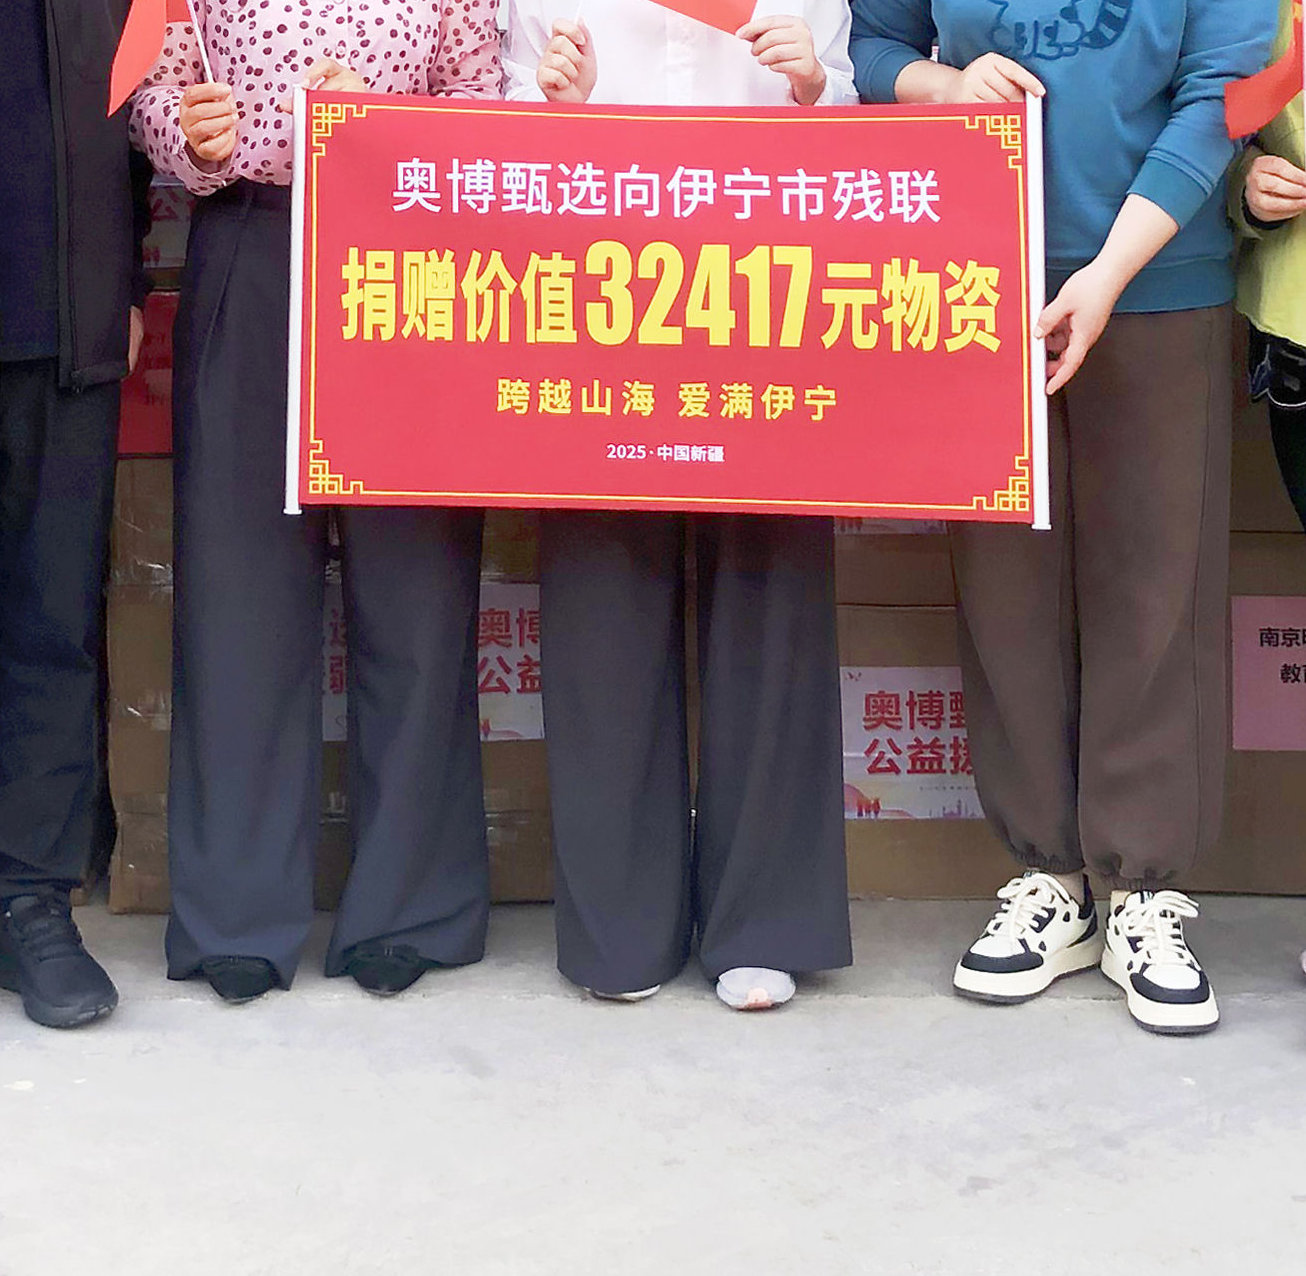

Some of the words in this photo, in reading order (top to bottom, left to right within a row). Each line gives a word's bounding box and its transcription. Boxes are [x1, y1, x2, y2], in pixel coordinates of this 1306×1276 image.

[391, 156, 942, 224] 奥博甄选向伊宁市残联
[340, 239, 1002, 354] 捐赠价值32417元物资
[496, 379, 656, 418] 跨越山海
[677, 382, 838, 421] 爱满伊宁
